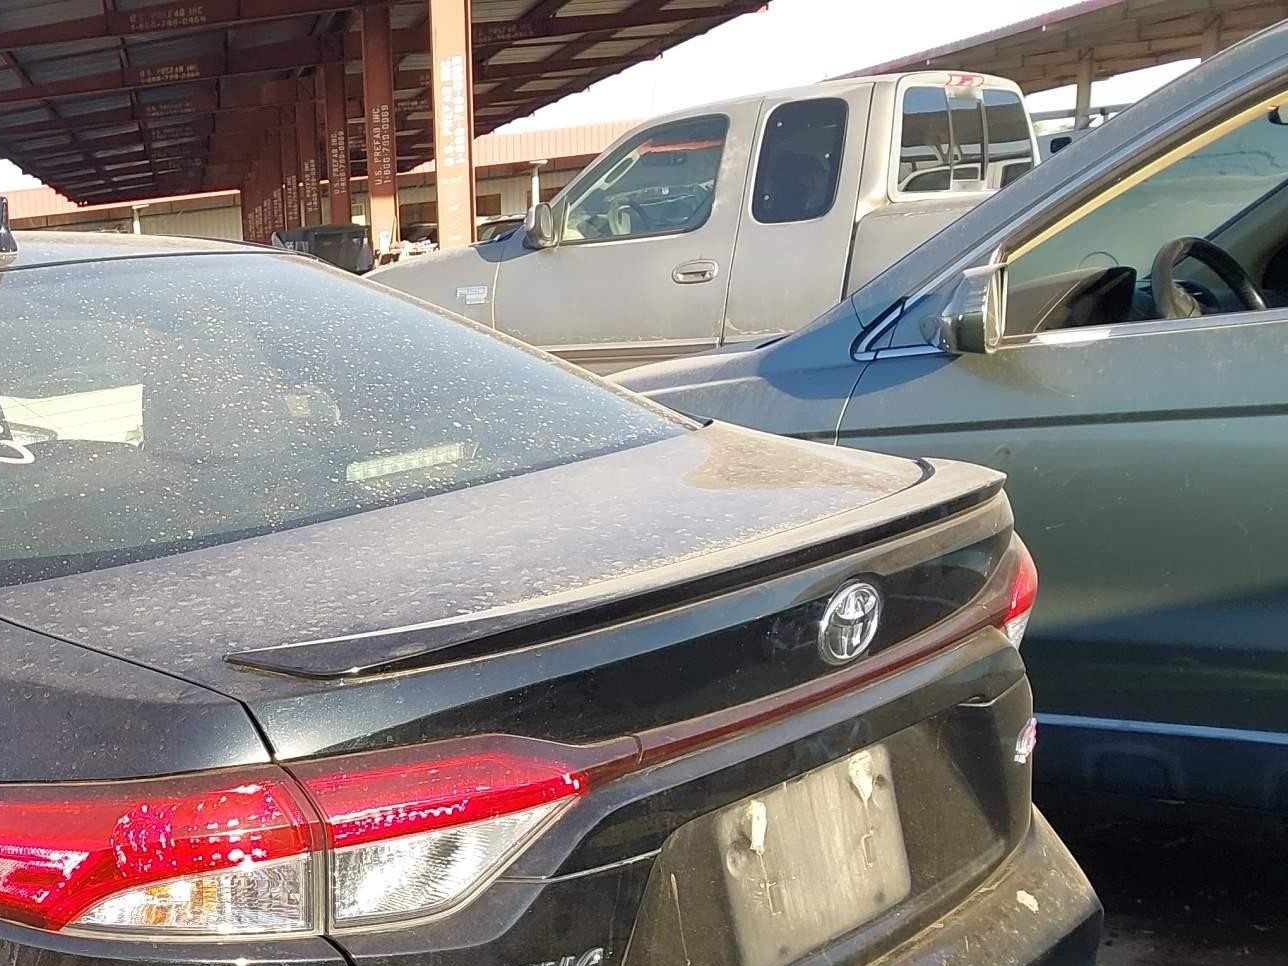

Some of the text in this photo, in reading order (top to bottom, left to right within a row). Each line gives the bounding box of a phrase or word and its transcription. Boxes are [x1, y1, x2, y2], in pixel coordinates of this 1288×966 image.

[372, 104, 383, 186] U.S. PREFAB INC.
